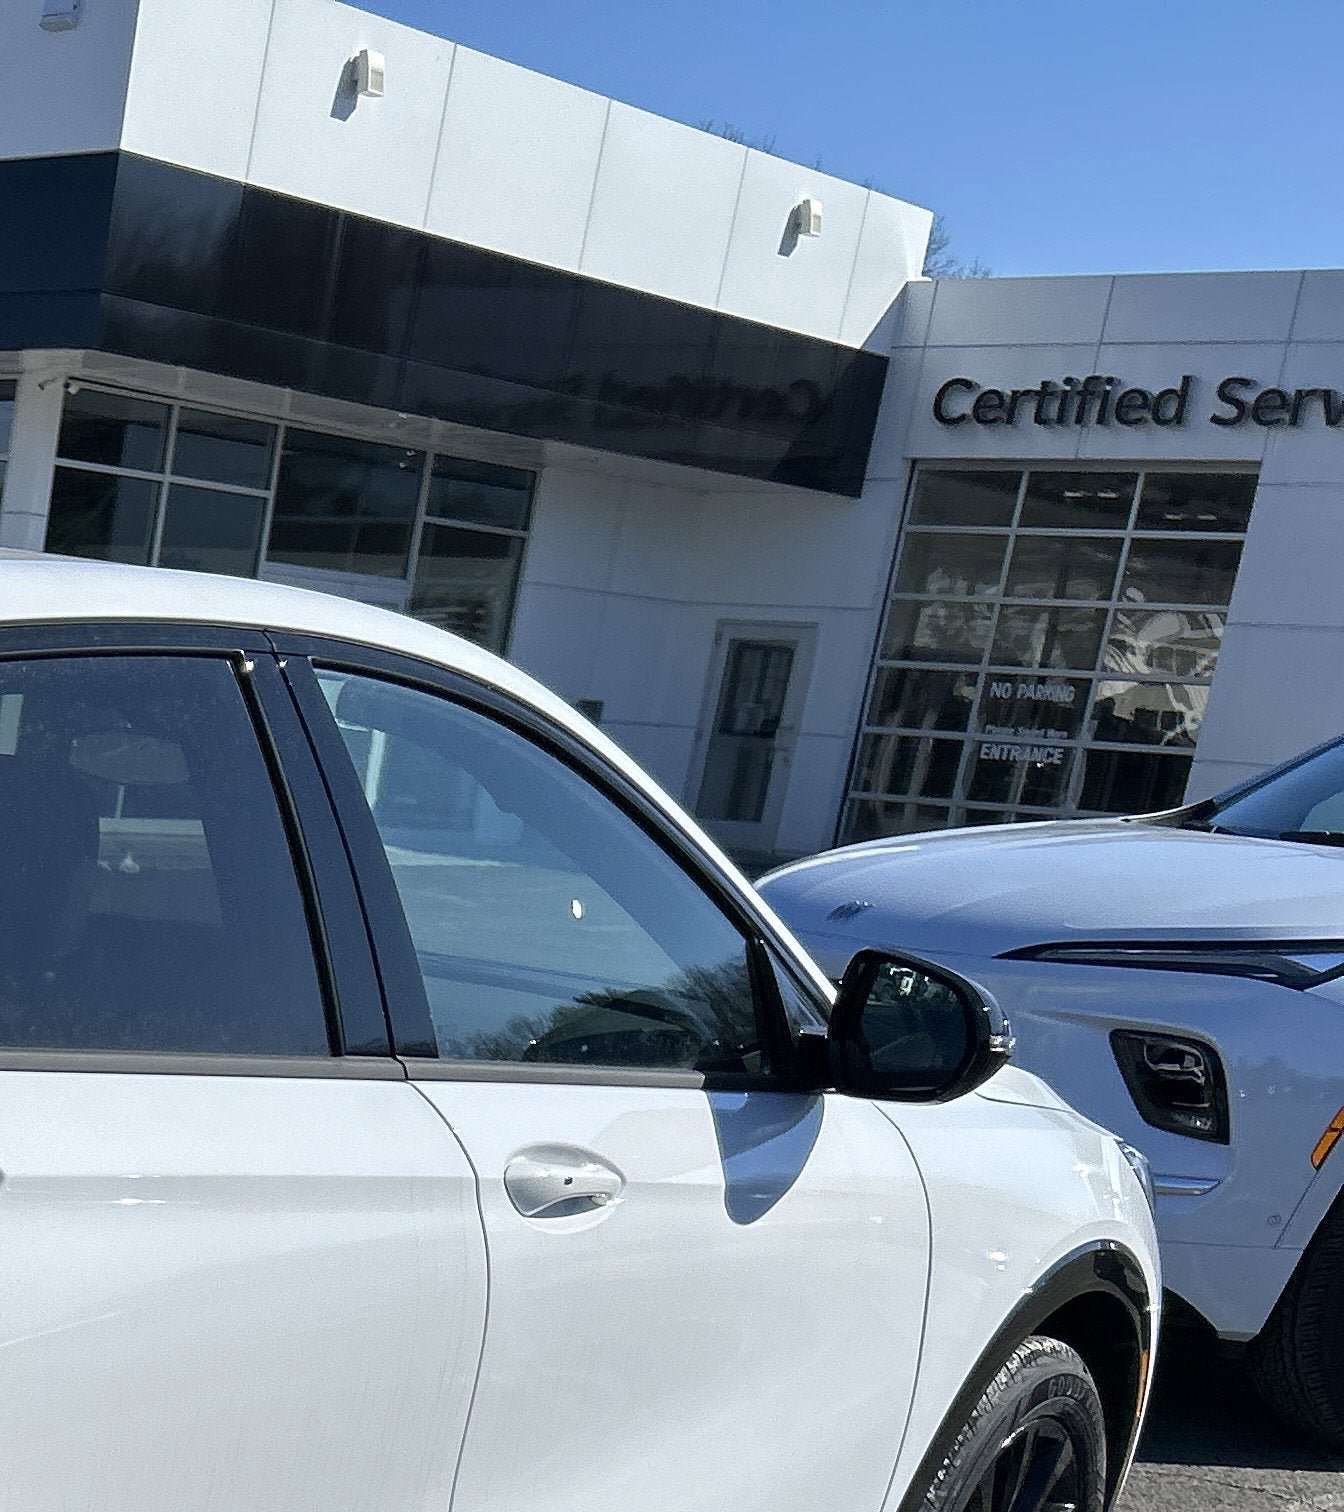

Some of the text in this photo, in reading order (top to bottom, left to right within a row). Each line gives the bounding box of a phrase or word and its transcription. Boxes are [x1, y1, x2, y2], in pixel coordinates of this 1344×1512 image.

[932, 374, 1196, 426] Certified
[989, 682, 1012, 699] NO
[979, 743, 1064, 765] ENTRANCE
